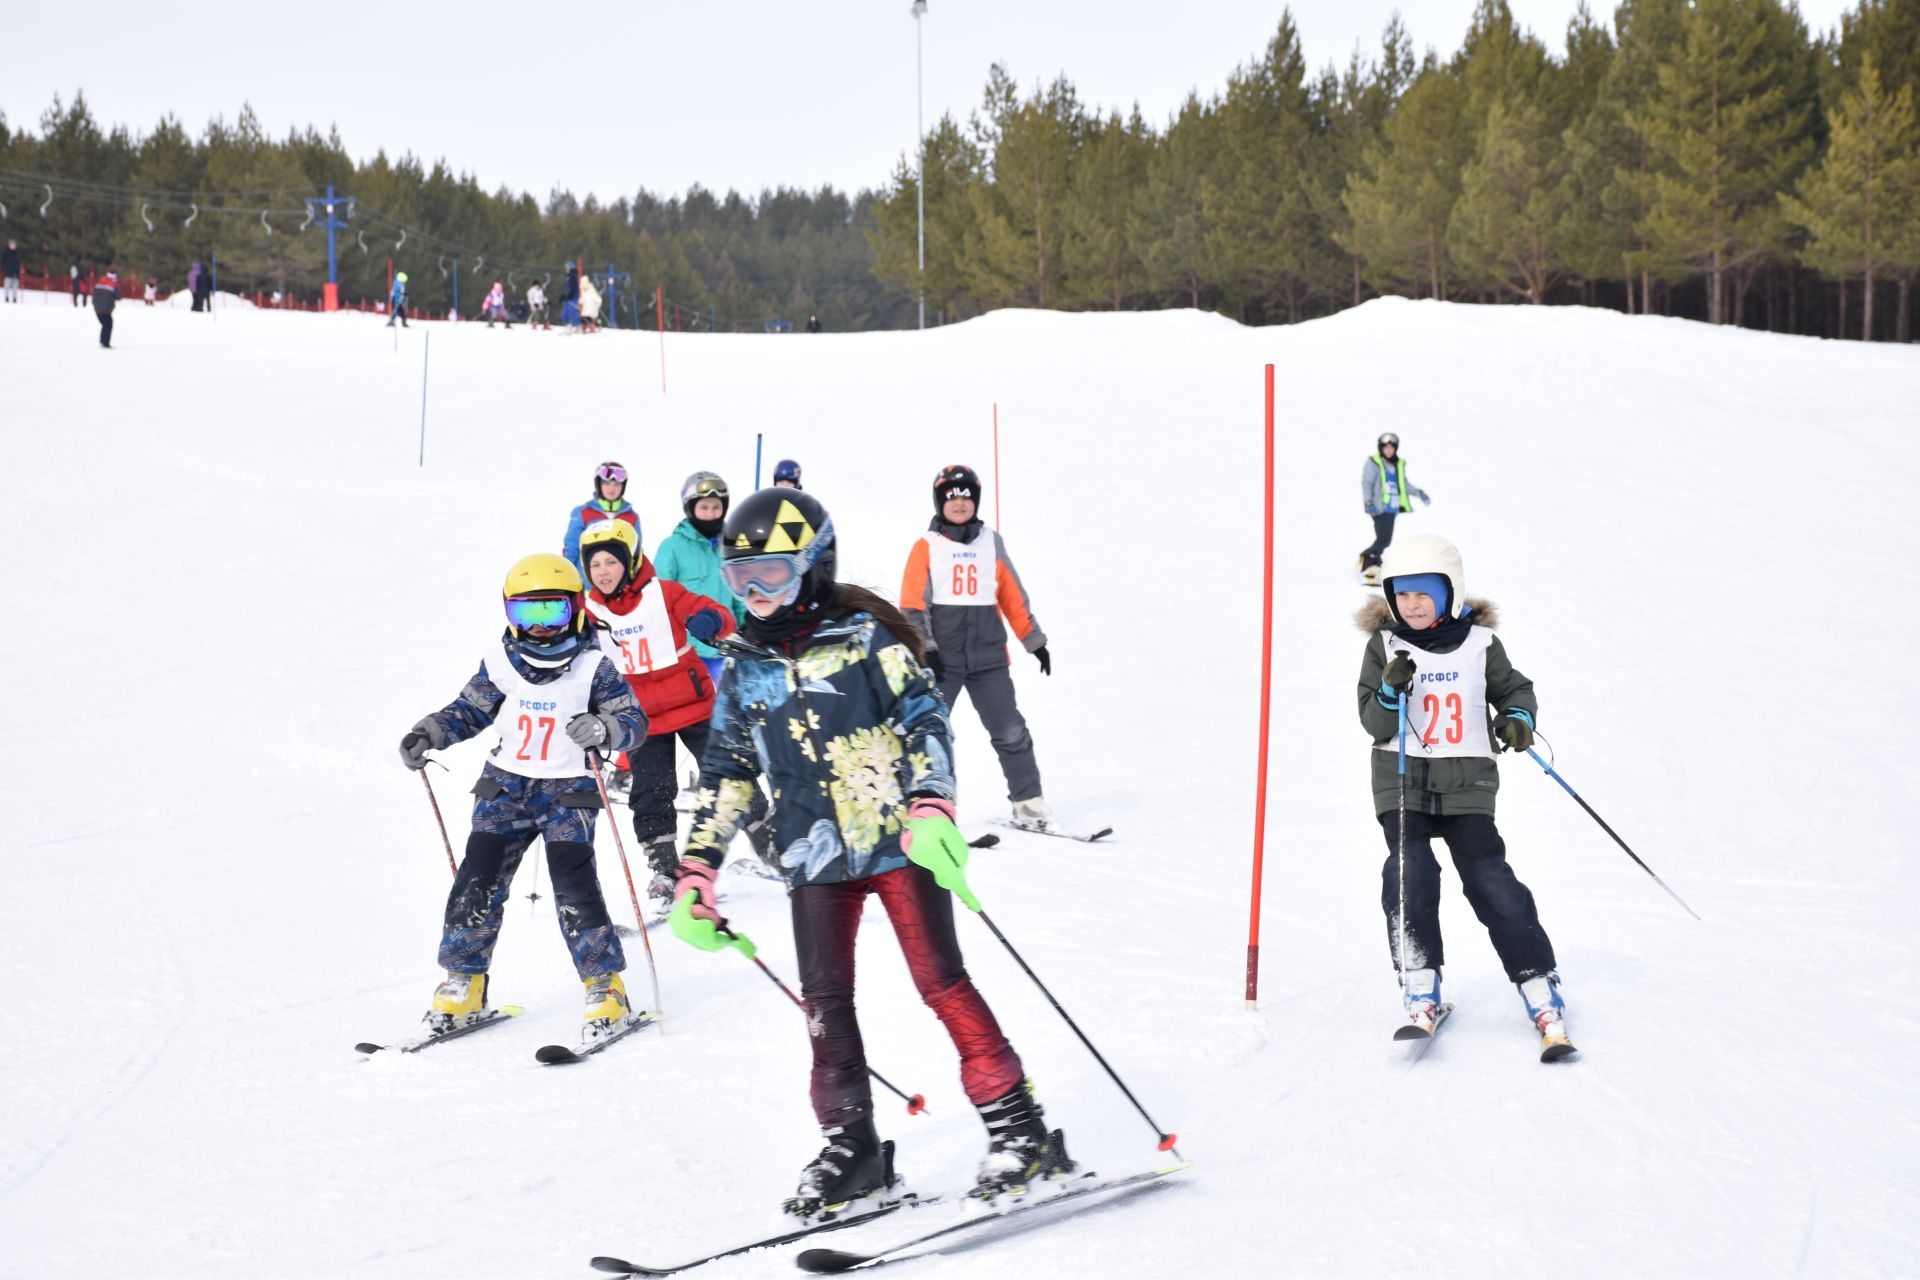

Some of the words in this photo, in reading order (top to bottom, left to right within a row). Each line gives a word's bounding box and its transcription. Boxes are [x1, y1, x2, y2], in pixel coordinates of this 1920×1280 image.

[952, 564, 977, 595] 66
[614, 624, 644, 637] РСФСР
[619, 637, 654, 674] 54
[1420, 671, 1459, 683] РСФСР
[520, 700, 556, 711] РСФСР
[1423, 693, 1463, 744] 23
[516, 714, 556, 760] 27
